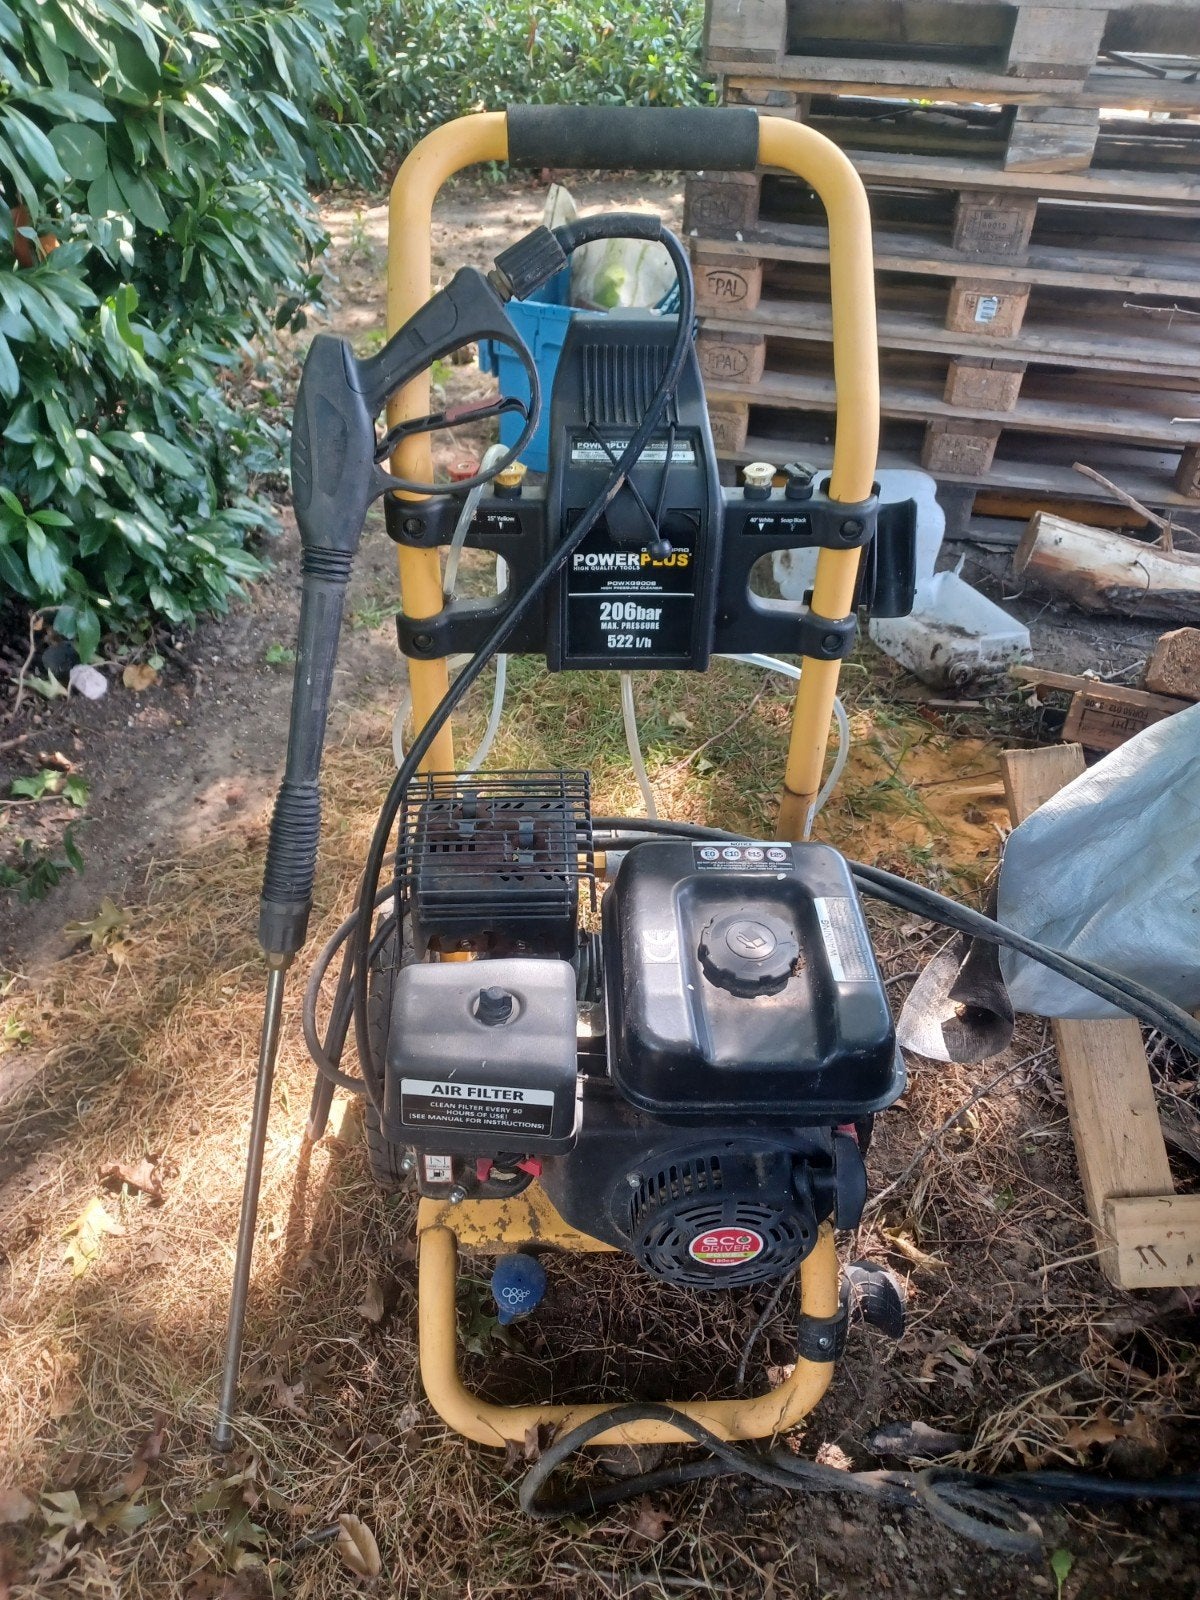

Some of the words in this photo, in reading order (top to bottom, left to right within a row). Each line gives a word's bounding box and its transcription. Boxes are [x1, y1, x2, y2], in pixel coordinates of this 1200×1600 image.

[600, 621, 620, 630] MAX.
[621, 621, 660, 630] PRESSURE
[607, 634, 634, 648] 522
[431, 1084, 462, 1096] AIR
[467, 1087, 524, 1101] FILTER
[430, 1101, 456, 1109] CLEAN
[485, 1105, 511, 1114] EVERY
[446, 1109, 475, 1117] HOURS
[408, 1112, 426, 1120] (SEE
[427, 1114, 464, 1123] MANUAL
[483, 1119, 545, 1130] INSTRUCTIONS)
[701, 1244, 751, 1253] DRIVER
